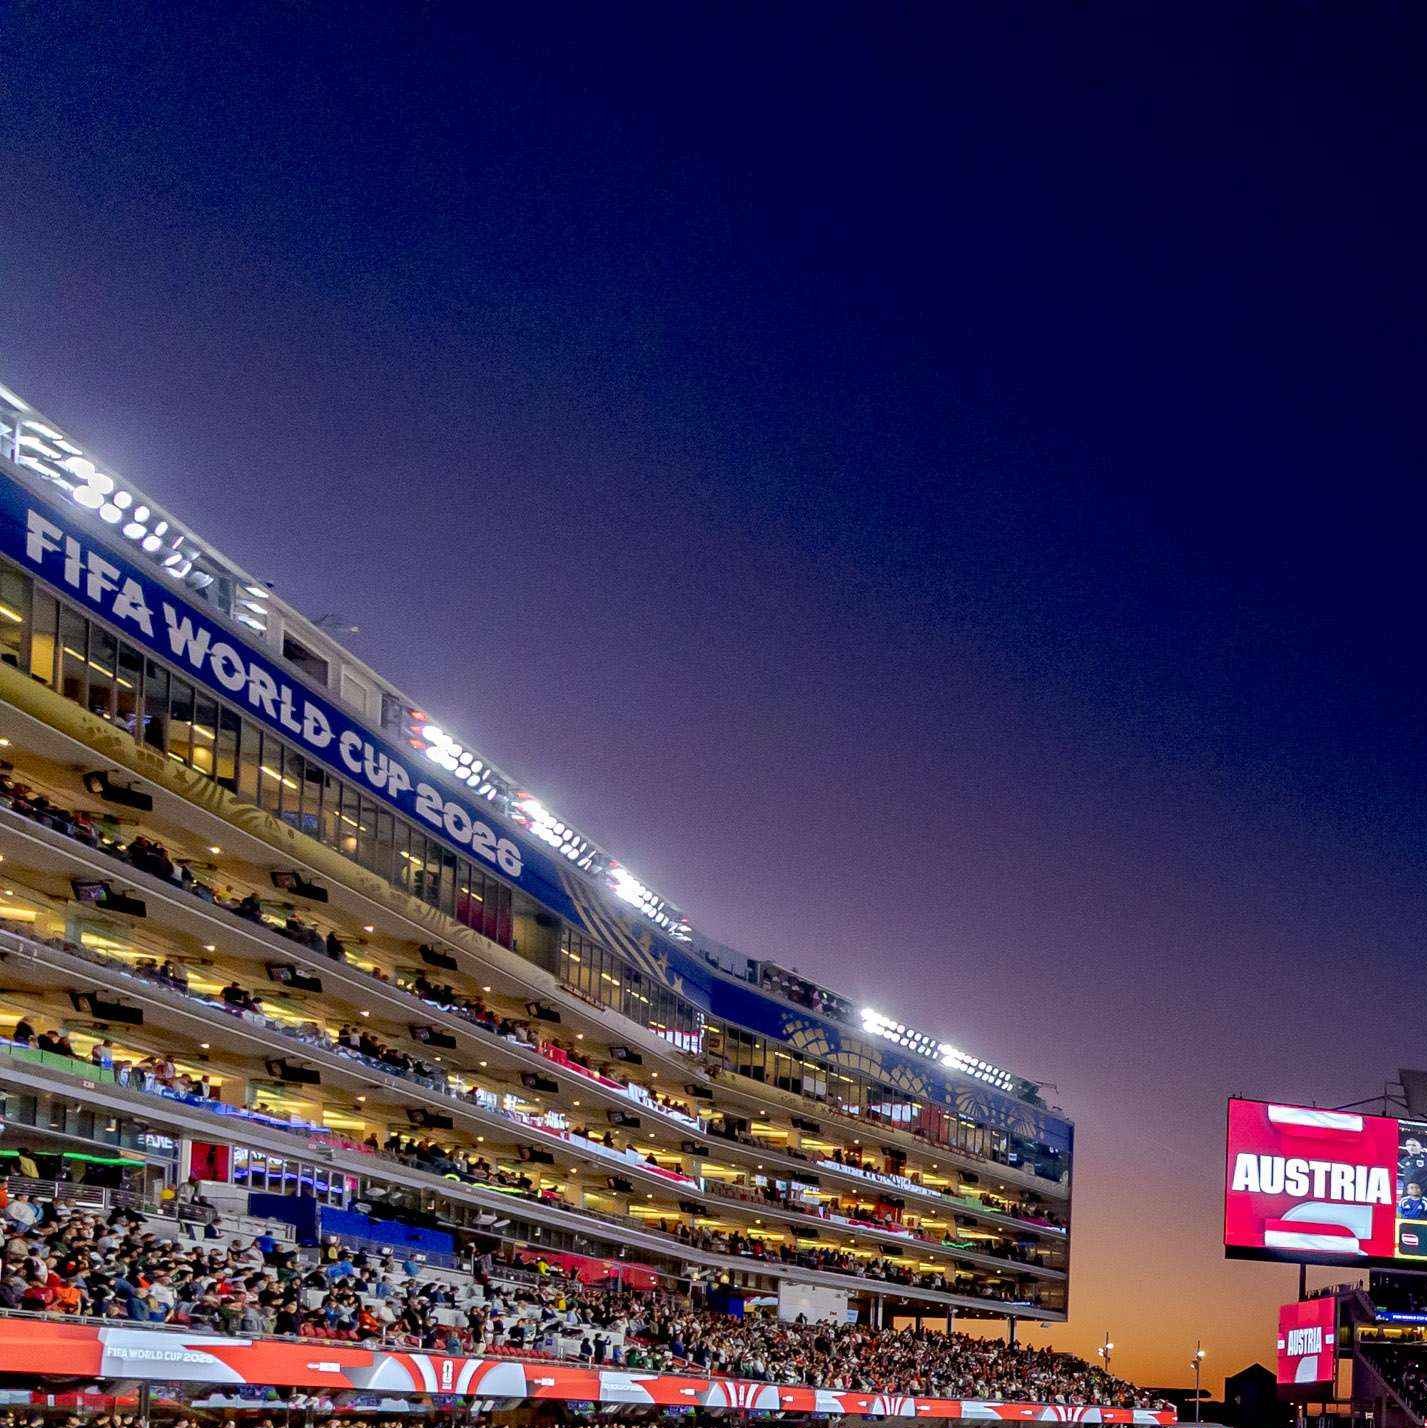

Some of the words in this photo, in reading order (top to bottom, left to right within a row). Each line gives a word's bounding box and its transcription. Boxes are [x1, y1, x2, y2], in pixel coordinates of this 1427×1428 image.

[26, 508, 154, 638] FIFA
[164, 605, 335, 749] WORLD
[339, 731, 414, 798] CUP
[416, 782, 524, 878] 2026
[1231, 1153, 1392, 1205] AUSTRIA
[107, 1347, 128, 1359] FIFA
[130, 1349, 163, 1360] WORLD
[164, 1351, 182, 1362] CUP
[1287, 1326, 1322, 1356] AUSTRIA
